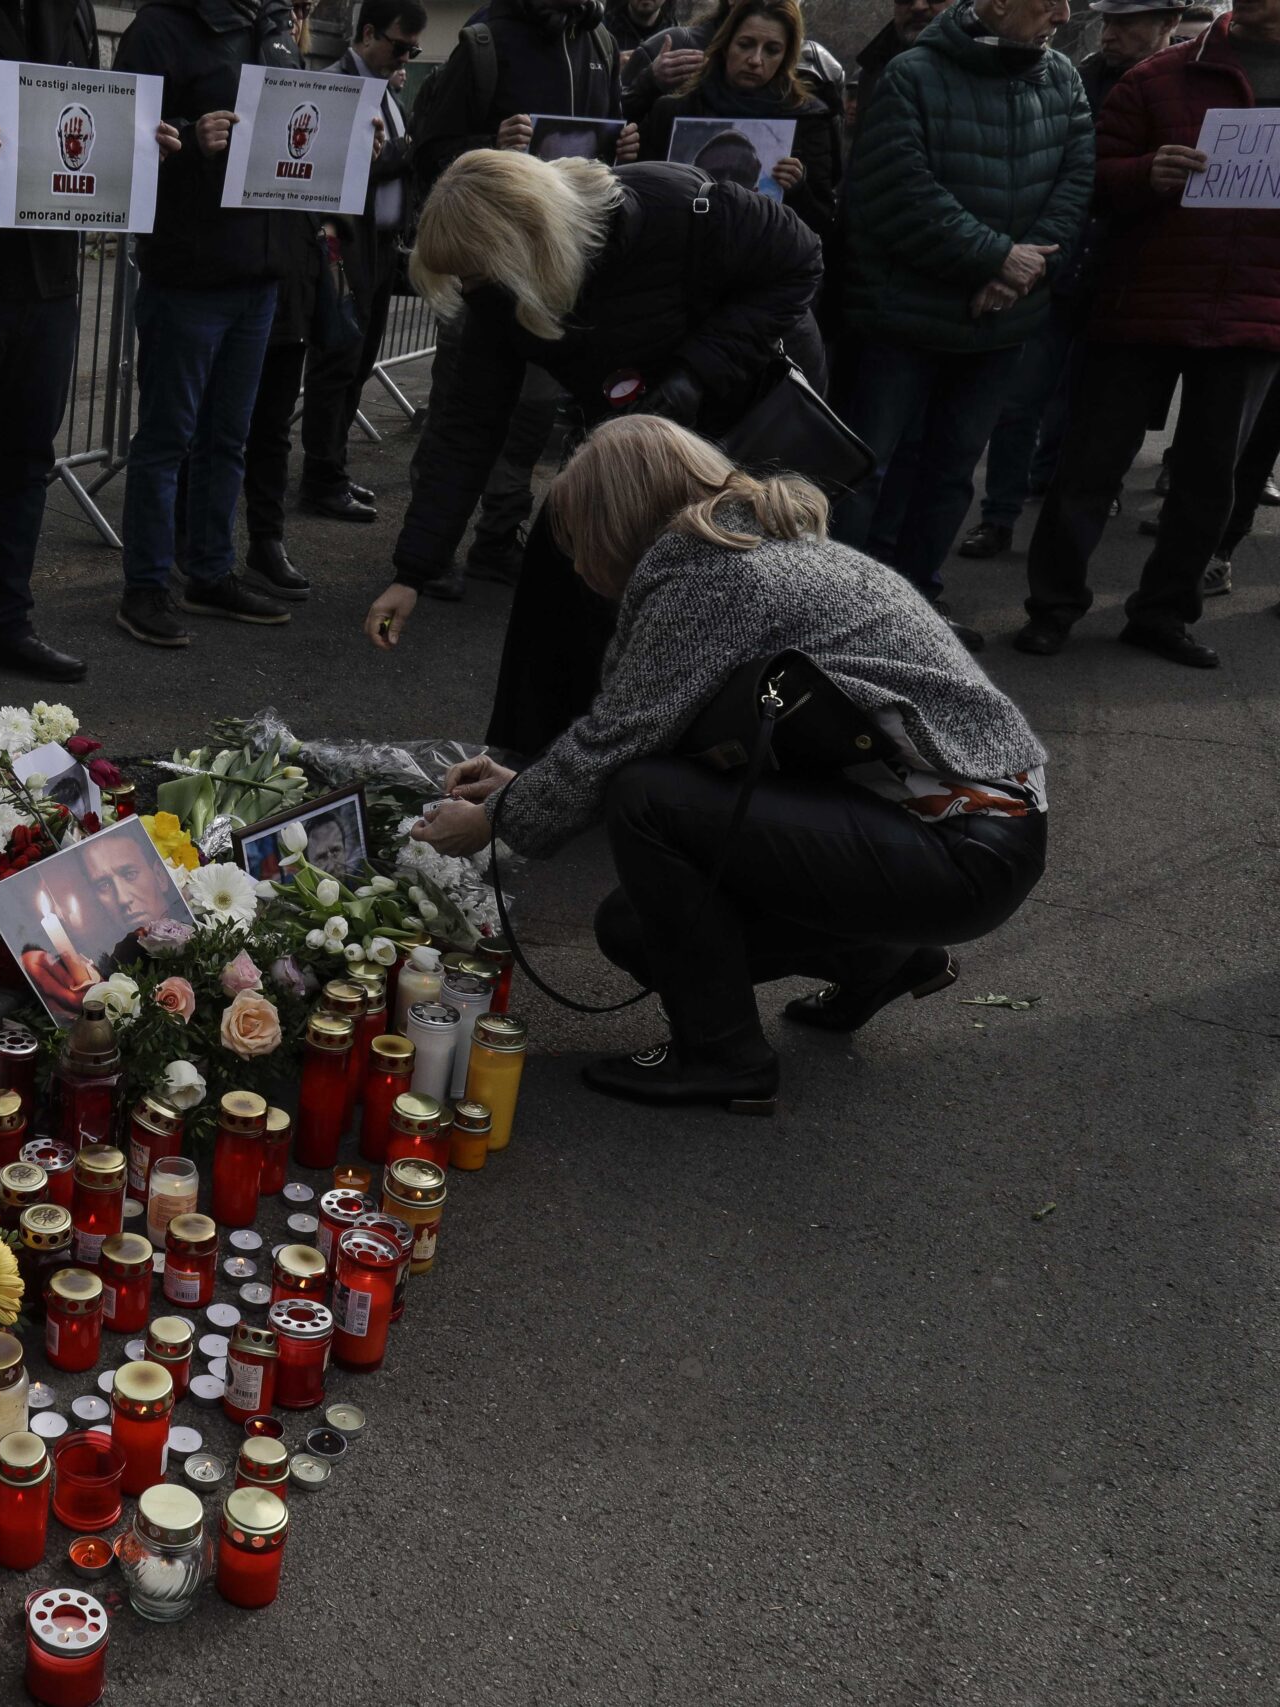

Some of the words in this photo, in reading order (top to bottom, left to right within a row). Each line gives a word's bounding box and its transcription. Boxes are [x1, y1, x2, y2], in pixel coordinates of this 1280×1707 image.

[19, 76, 33, 87] Nu
[36, 78, 69, 92] castigi
[71, 82, 105, 95] alegeri
[108, 85, 136, 96] libere
[264, 78, 276, 86] You
[279, 79, 297, 87] don't
[298, 81, 311, 89] win
[312, 82, 326, 91] free
[276, 161, 313, 179] KILLER
[52, 174, 95, 194] KILLER
[243, 190, 251, 199] by
[252, 191, 285, 200] murdering
[287, 192, 299, 200] the
[300, 193, 341, 203] opposition!
[19, 210, 71, 221] omorand
[74, 211, 125, 224] opozitia!
